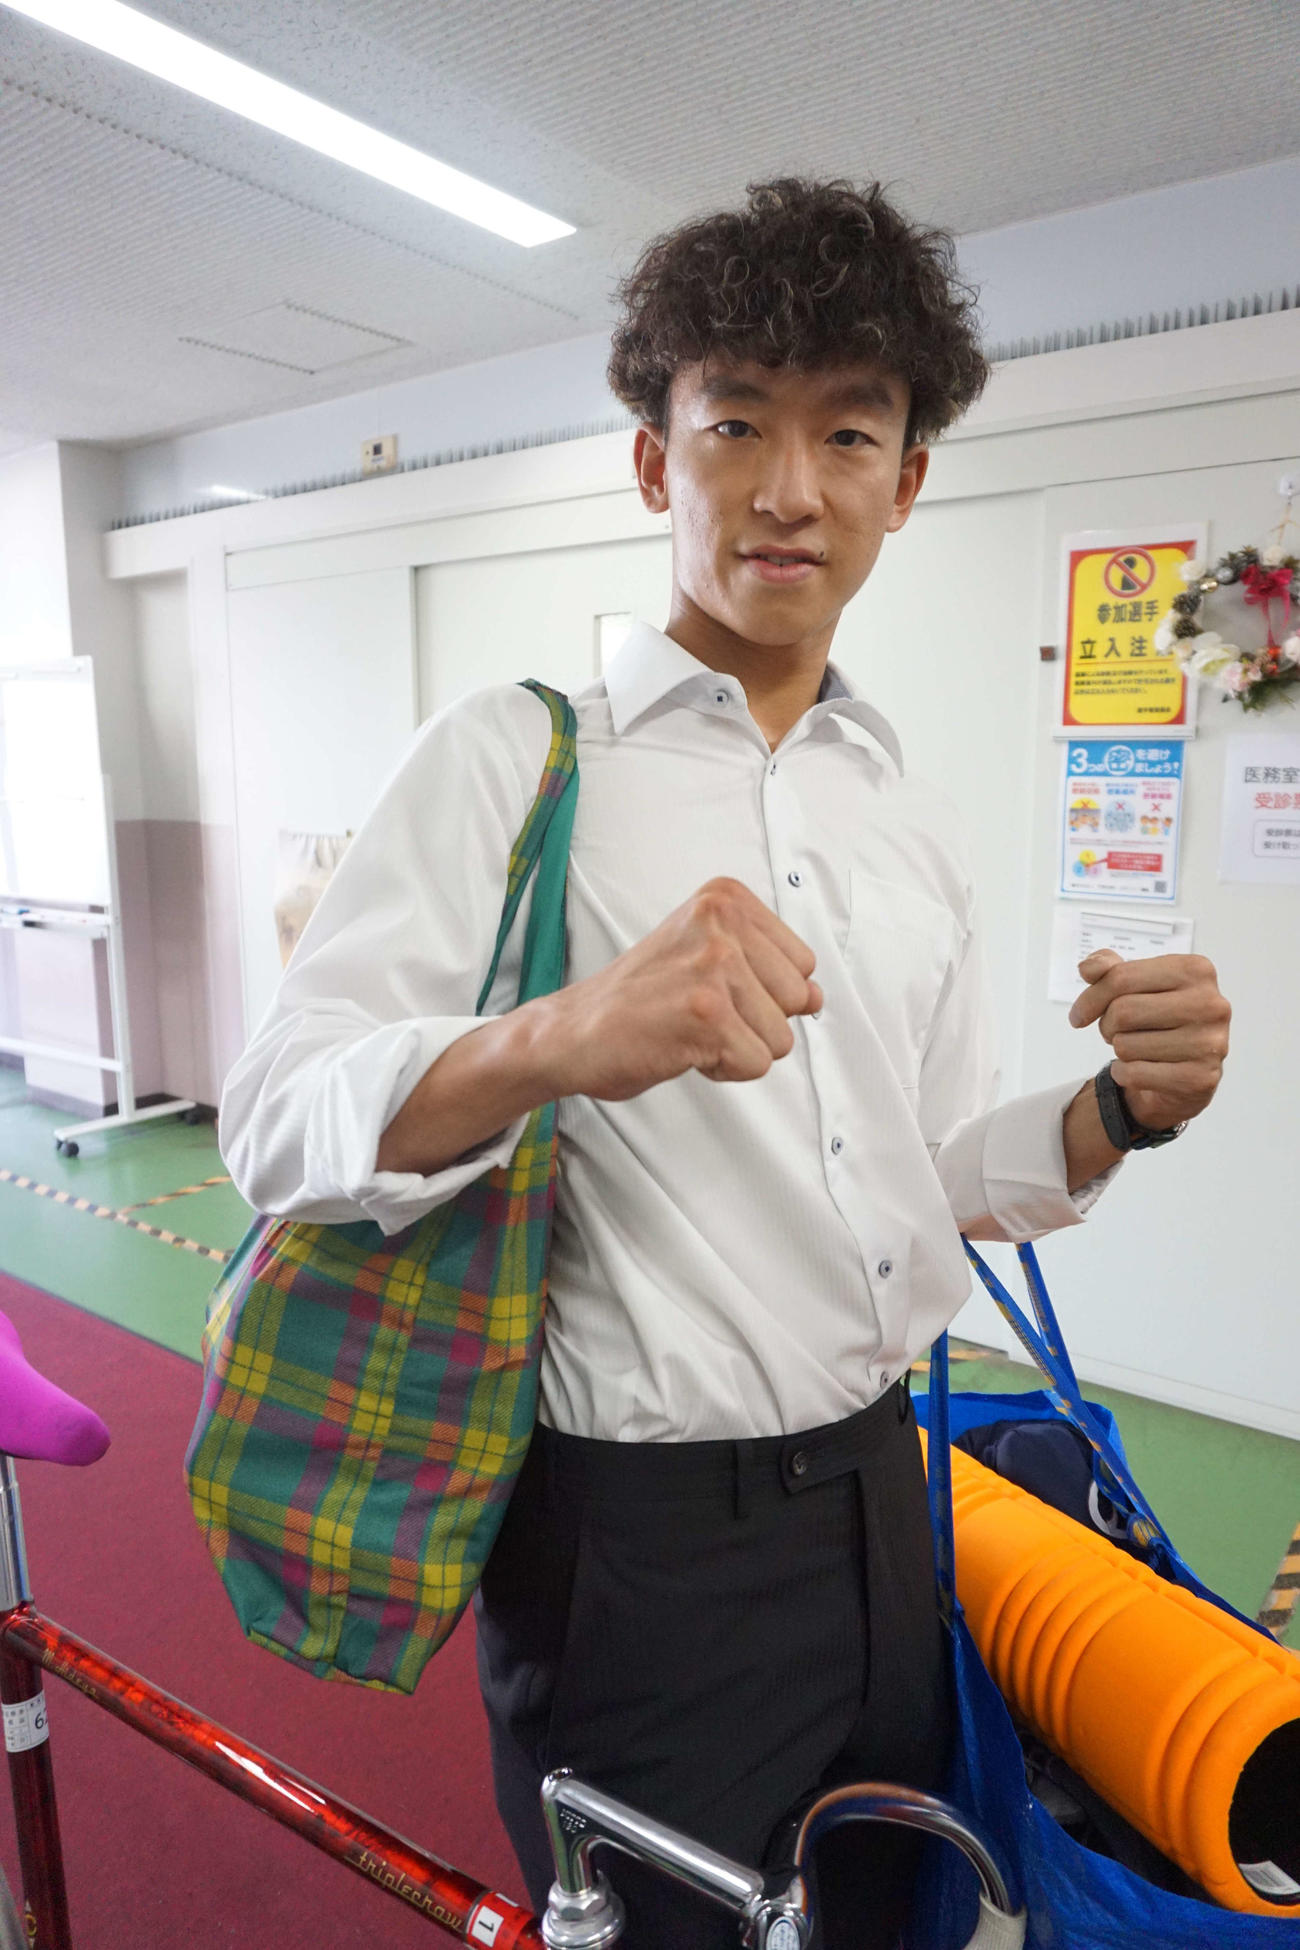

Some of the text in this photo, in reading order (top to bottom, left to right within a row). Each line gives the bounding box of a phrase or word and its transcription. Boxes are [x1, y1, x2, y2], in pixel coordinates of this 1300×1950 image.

[1097, 600, 1159, 624] 参加選手
[478, 1919, 495, 1932] 1
